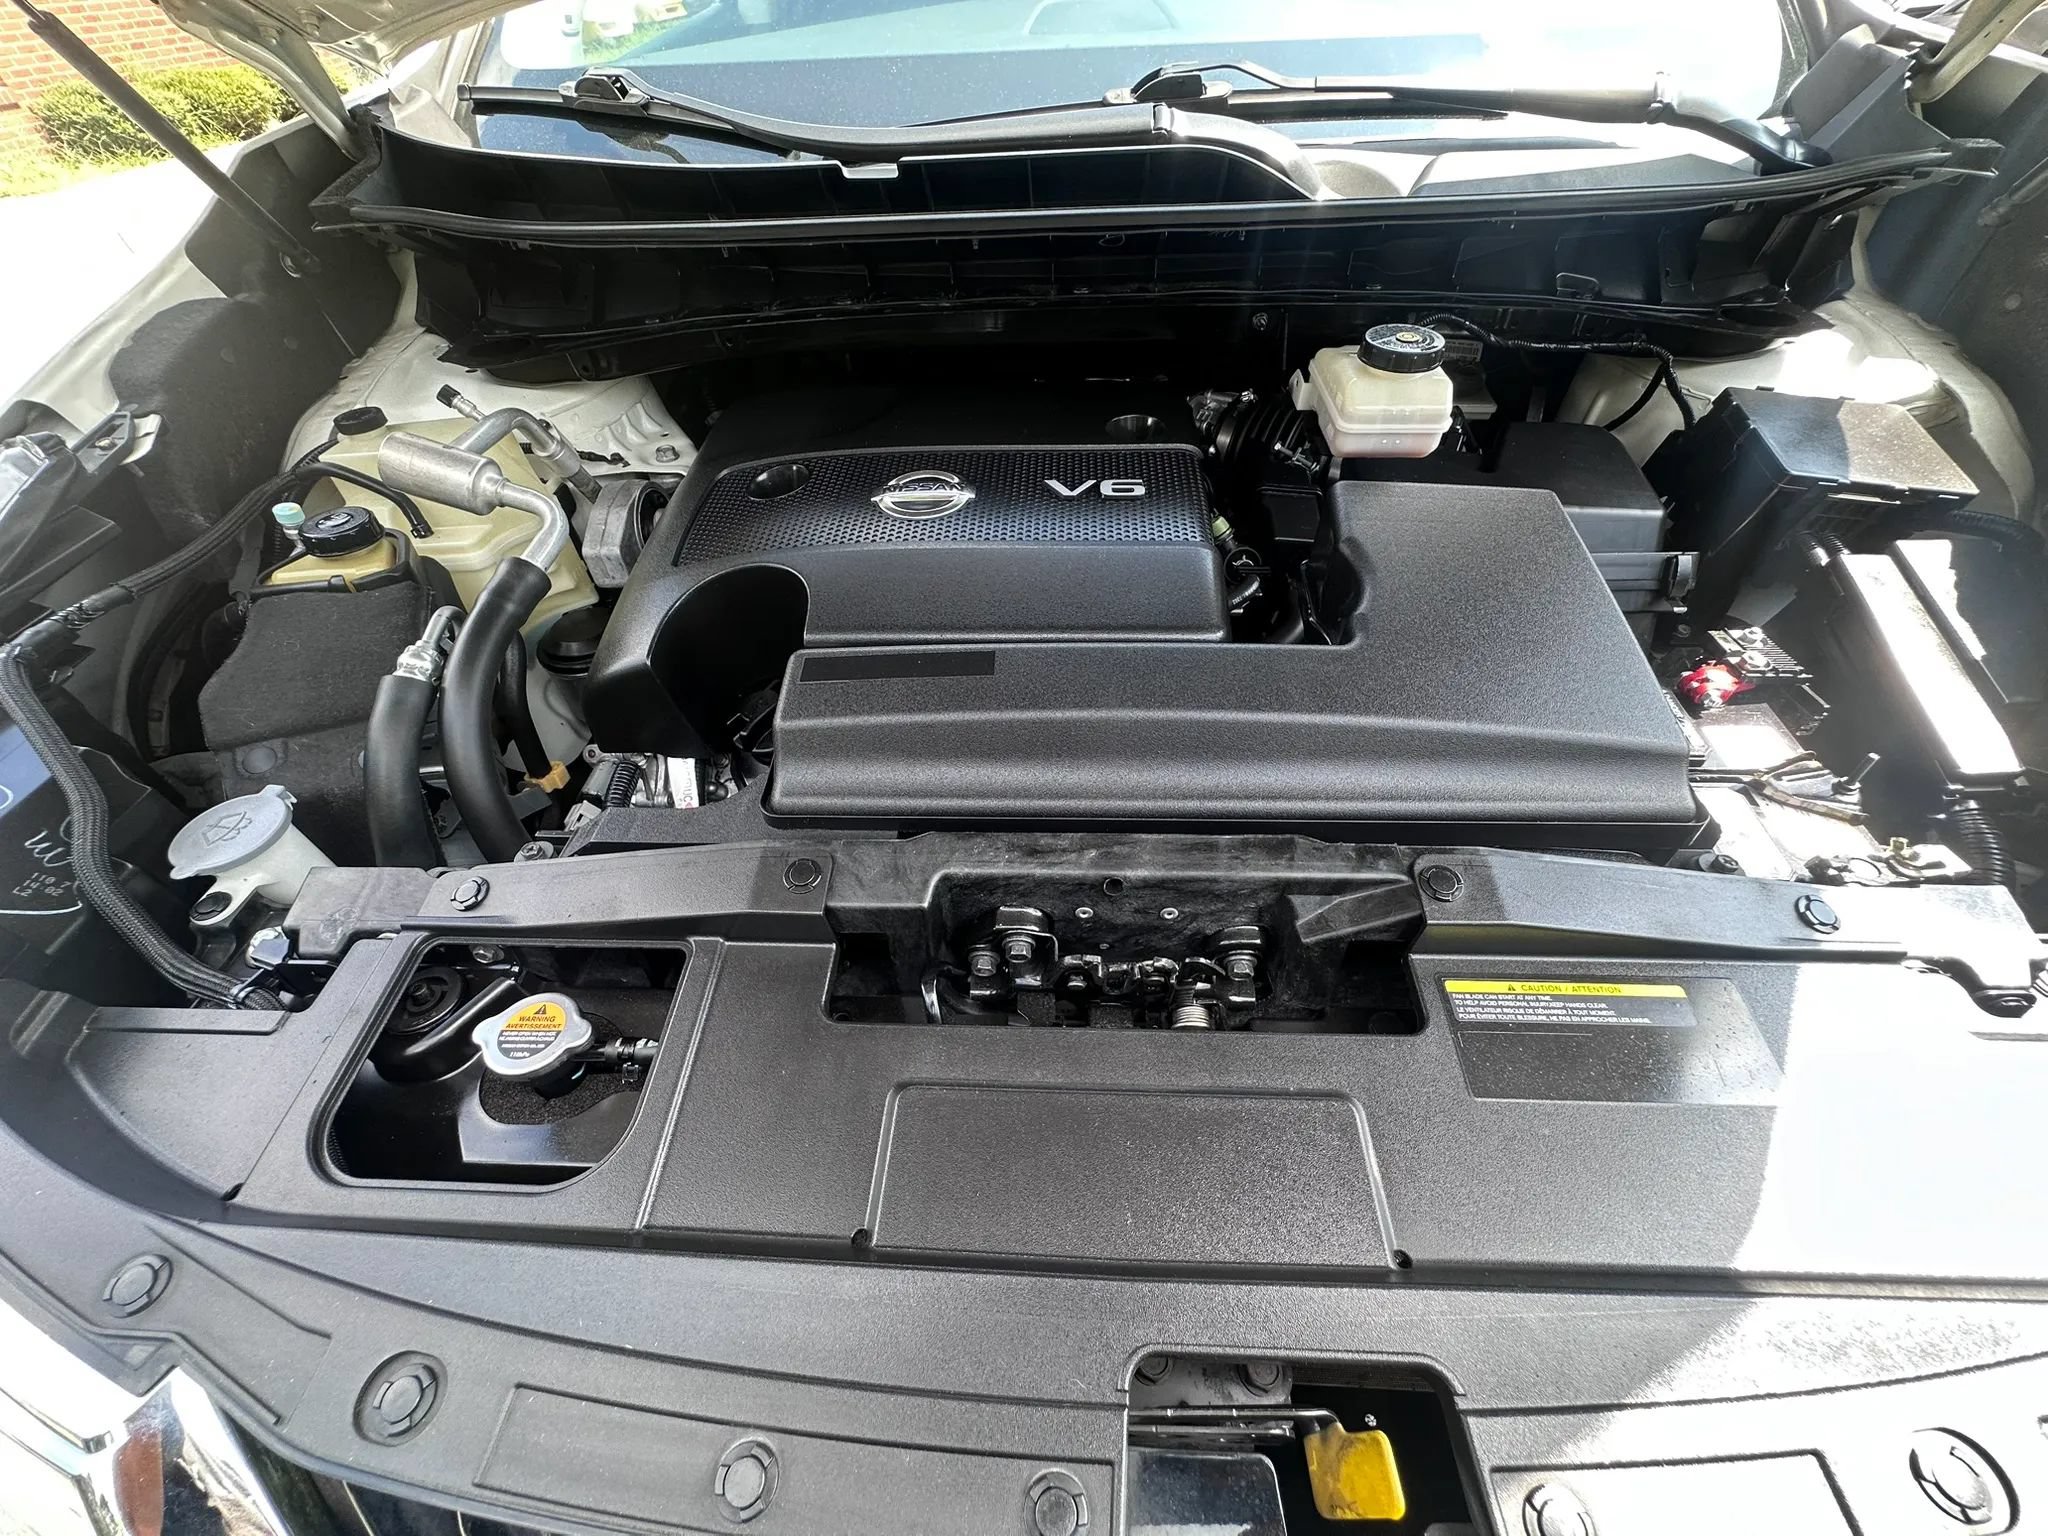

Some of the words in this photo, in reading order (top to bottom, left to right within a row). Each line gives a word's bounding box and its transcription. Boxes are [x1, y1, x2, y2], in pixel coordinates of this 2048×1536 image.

[882, 482, 966, 493] NISSAN
[1044, 479, 1146, 497] V6
[1521, 984, 1562, 992] CAUTION
[1572, 985, 1621, 993] ATTENTION
